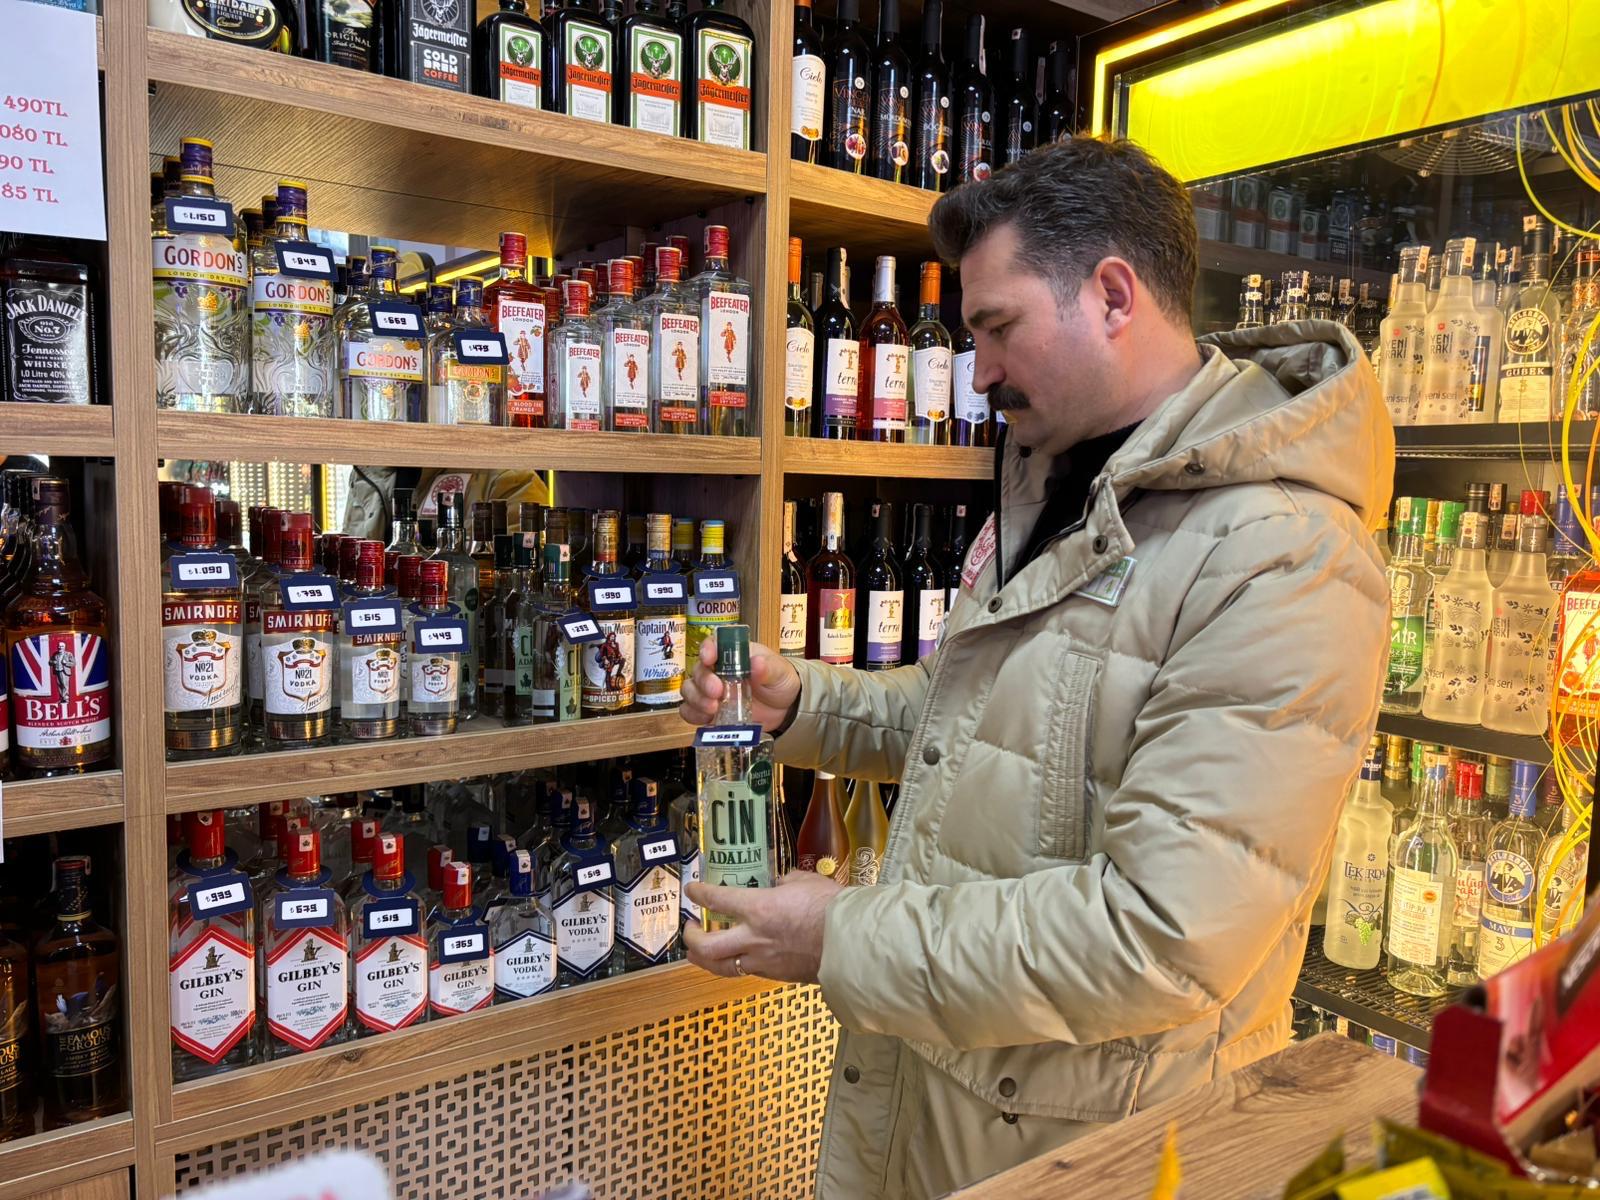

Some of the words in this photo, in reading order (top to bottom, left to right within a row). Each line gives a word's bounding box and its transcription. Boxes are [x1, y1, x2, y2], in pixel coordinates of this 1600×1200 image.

[325, 31, 372, 48] ORIGINAL
[412, 22, 468, 48] Jägermeister
[423, 49, 458, 63] COLD
[423, 59, 459, 75] BREW
[423, 69, 458, 83] COFFEE
[800, 66, 823, 84] Cielo
[42, 130, 68, 147] TL
[29, 158, 55, 174] TL
[33, 187, 59, 204] TL
[164, 245, 243, 273] GORDON'S
[265, 281, 331, 304] GORDON'S
[6, 298, 36, 320] JACK
[710, 296, 749, 314] BEEFEATER
[502, 305, 544, 322] BEEFEATER
[34, 325, 61, 335] No.7
[661, 317, 698, 334] BEEFEATER
[615, 332, 649, 347] BEEFEATER
[1431, 332, 1453, 342] YENİ
[569, 346, 601, 360] BEEFEATER
[787, 339, 810, 354] Cielo
[24, 360, 75, 369] WHISKEY
[357, 351, 418, 371] GORDON'S
[928, 357, 949, 370] Cielo
[885, 375, 906, 389] terra
[164, 604, 239, 621] SMIRNOFF
[696, 600, 738, 615] GORDON
[267, 613, 332, 628] SMIRNOFF
[878, 620, 901, 634] terra
[637, 621, 667, 638] Captain
[780, 626, 804, 639] terra
[520, 626, 533, 657] Cİ
[189, 672, 219, 682] VODKA
[643, 667, 670, 679] White
[289, 679, 316, 688] VODKA
[1497, 678, 1513, 689] seri
[588, 694, 617, 704] SPICED
[25, 695, 102, 722] BELL'S
[27, 719, 56, 728] BLENDED
[56, 718, 81, 726] SCOTCH
[711, 790, 755, 846] CİN
[709, 846, 762, 865] ADALİN
[633, 888, 678, 908] GILBEY'S
[640, 904, 671, 917] VODKA
[561, 912, 608, 928] GILBEY'S
[568, 926, 600, 937] VODKA
[1488, 919, 1517, 937] MAVİ
[1494, 936, 1506, 951] 3
[506, 953, 551, 966] GILBEY'S
[278, 961, 342, 984] GILBEY'S
[367, 962, 420, 982] GILBEY'S
[443, 966, 488, 983] GILBEY'S
[513, 964, 544, 975] VODKA
[179, 967, 244, 991] GILBEY'S
[297, 979, 322, 993] GIN
[383, 977, 404, 989] GIN
[457, 979, 475, 989] GIN
[199, 987, 225, 1000] GIN
[67, 1026, 111, 1044] FAMOUS
[67, 1036, 111, 1052] GROUSE
